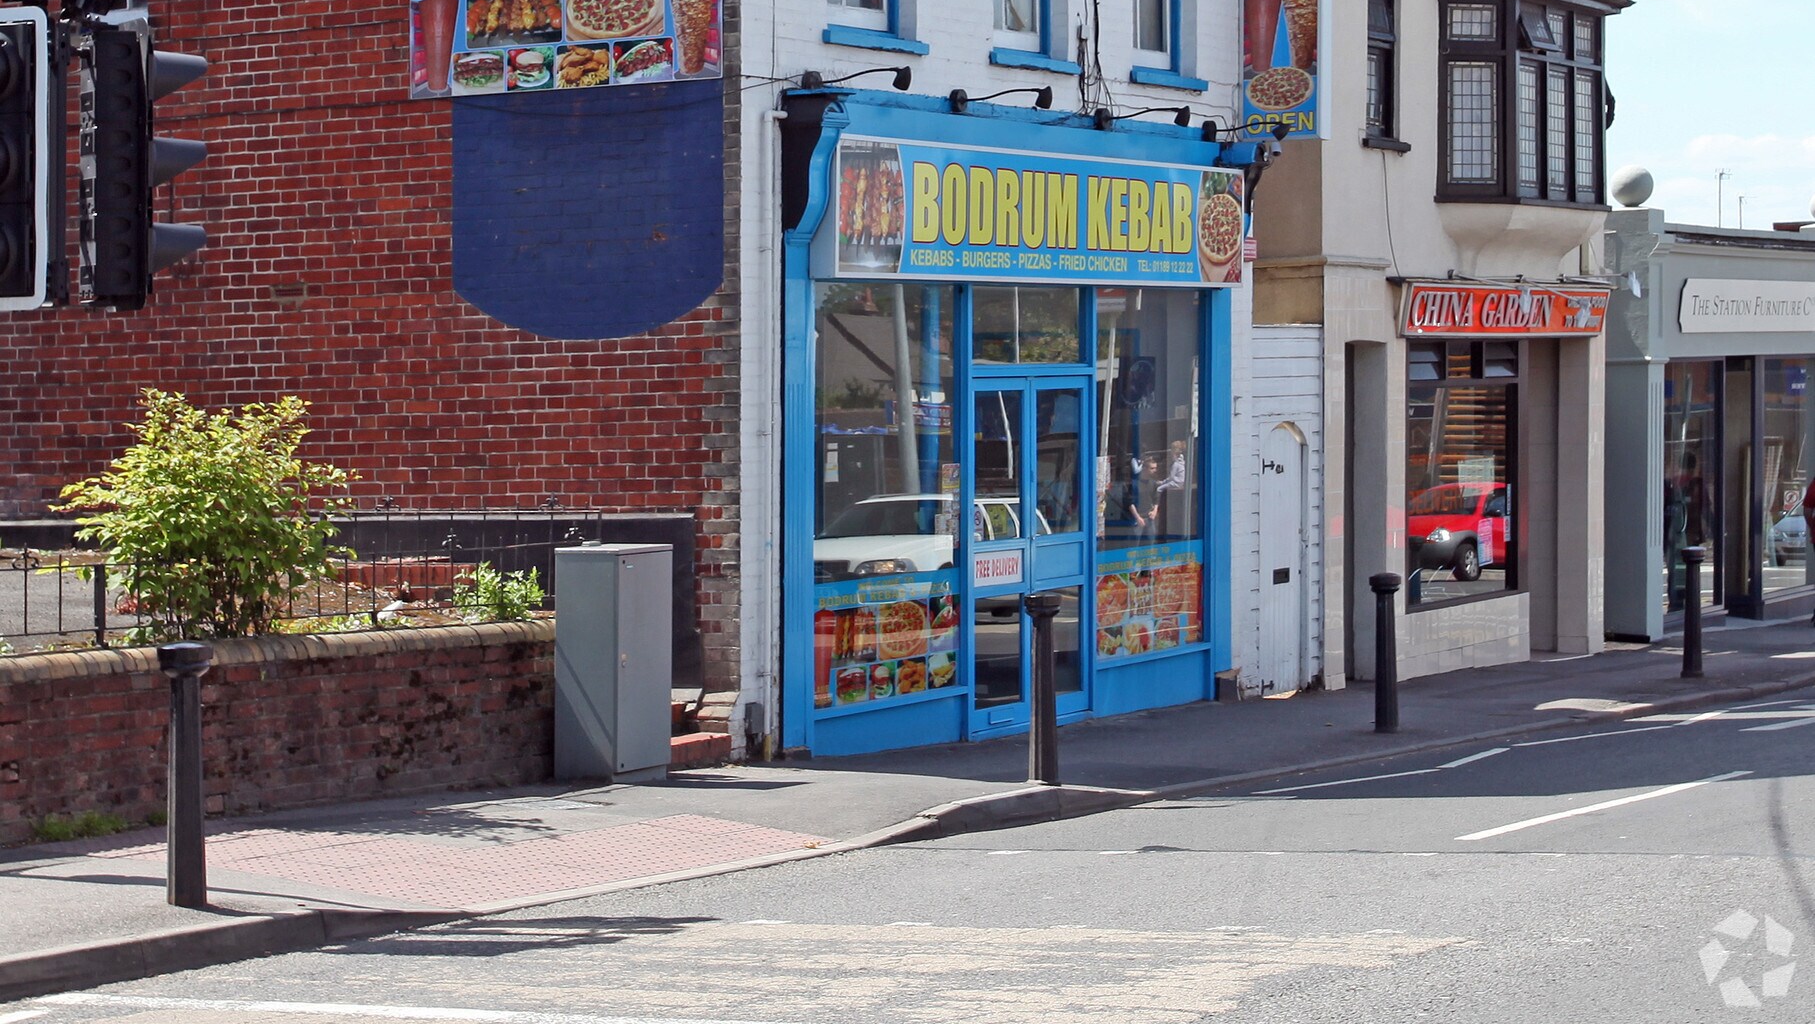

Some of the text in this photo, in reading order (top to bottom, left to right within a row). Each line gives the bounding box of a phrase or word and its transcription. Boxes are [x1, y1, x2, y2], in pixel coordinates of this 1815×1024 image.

[1246, 111, 1314, 135] OPEN
[911, 161, 1193, 254] BODRUM KEBAB
[910, 249, 954, 266] KEBABS
[962, 251, 1011, 268] BURGERS
[1018, 253, 1052, 270] PIZZAS
[1059, 254, 1086, 271] FRIED
[1087, 255, 1127, 272] CHICKEN
[1411, 291, 1474, 327] CHINA
[975, 556, 1020, 578] FREE DELIVERY
